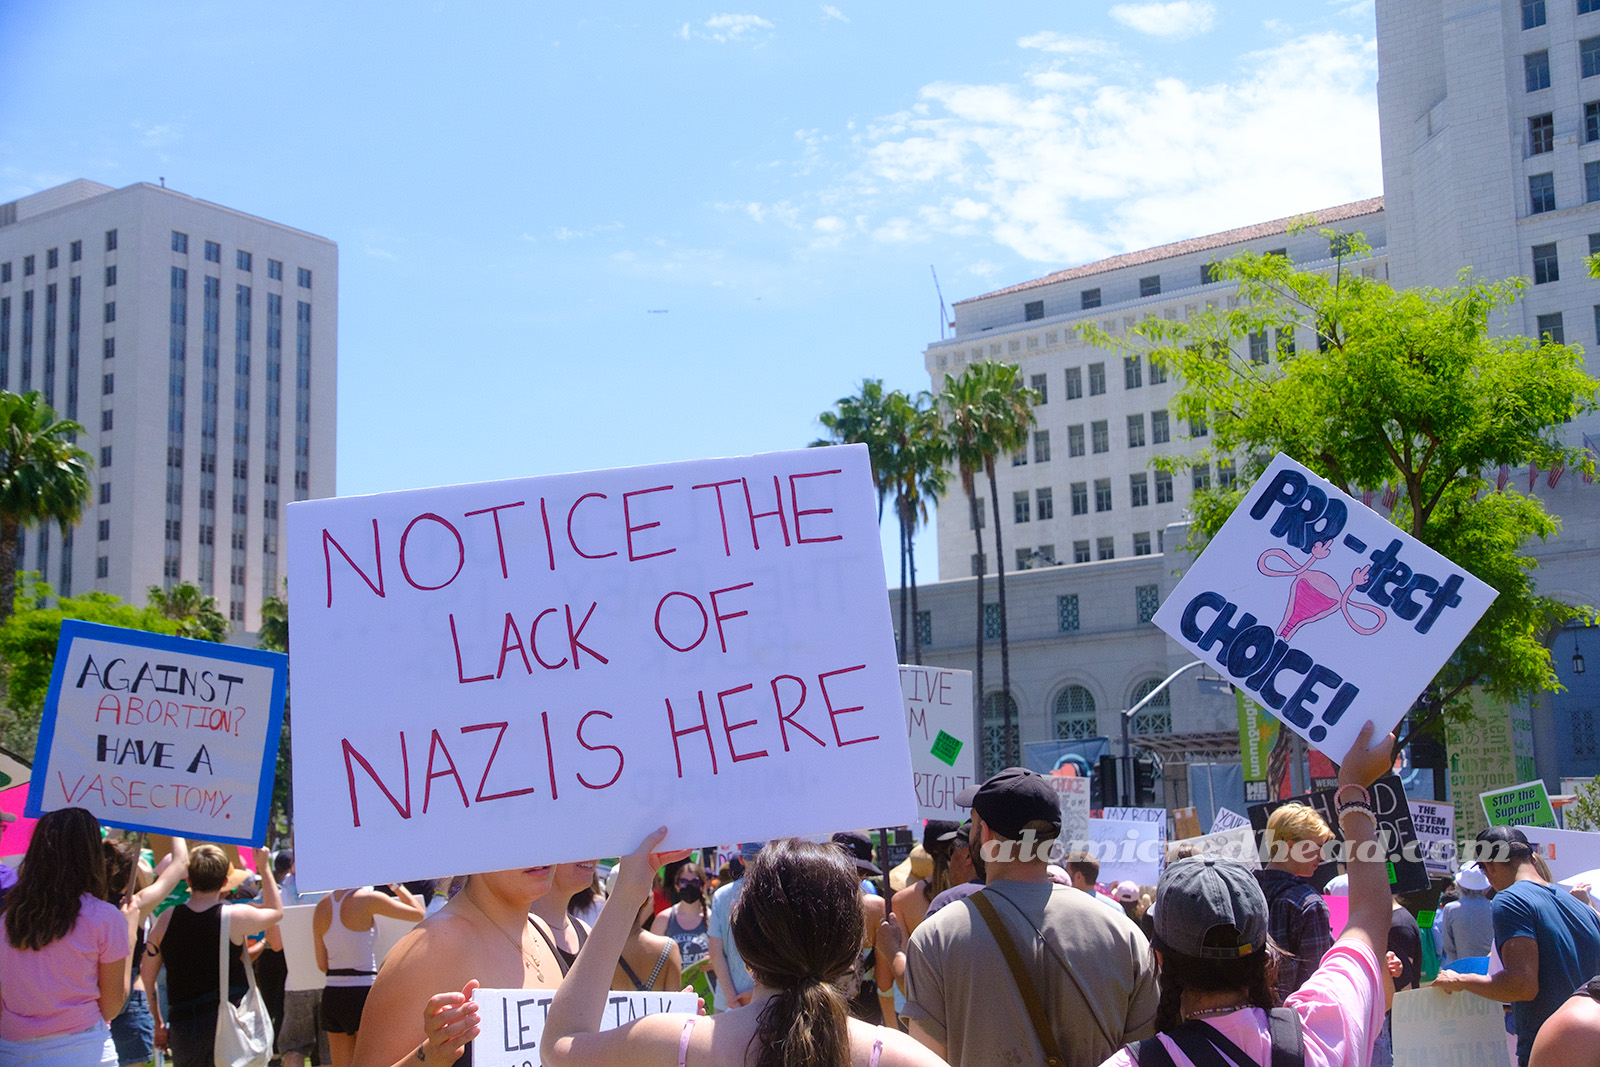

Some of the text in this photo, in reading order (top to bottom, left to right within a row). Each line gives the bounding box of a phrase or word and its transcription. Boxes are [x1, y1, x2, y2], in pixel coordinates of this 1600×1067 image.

[323, 470, 843, 608] NOTICE THE
[450, 582, 754, 684] LACK OF
[76, 654, 244, 705] AGAINST
[1180, 591, 1360, 743] CHOICE!
[95, 694, 247, 737] ABORTION?
[97, 734, 213, 775] HAVE A
[342, 664, 880, 828] NAZIS HERE
[57, 771, 233, 819] VASECTOMY.
[1451, 772, 1516, 788] everyone
[1492, 789, 1535, 807] STOP the
[1106, 809, 1128, 820] MY
[1412, 814, 1446, 826] YSTEM
[1418, 805, 1436, 815] THE
[1495, 800, 1541, 819] Supreme
[1508, 812, 1535, 828] Court
